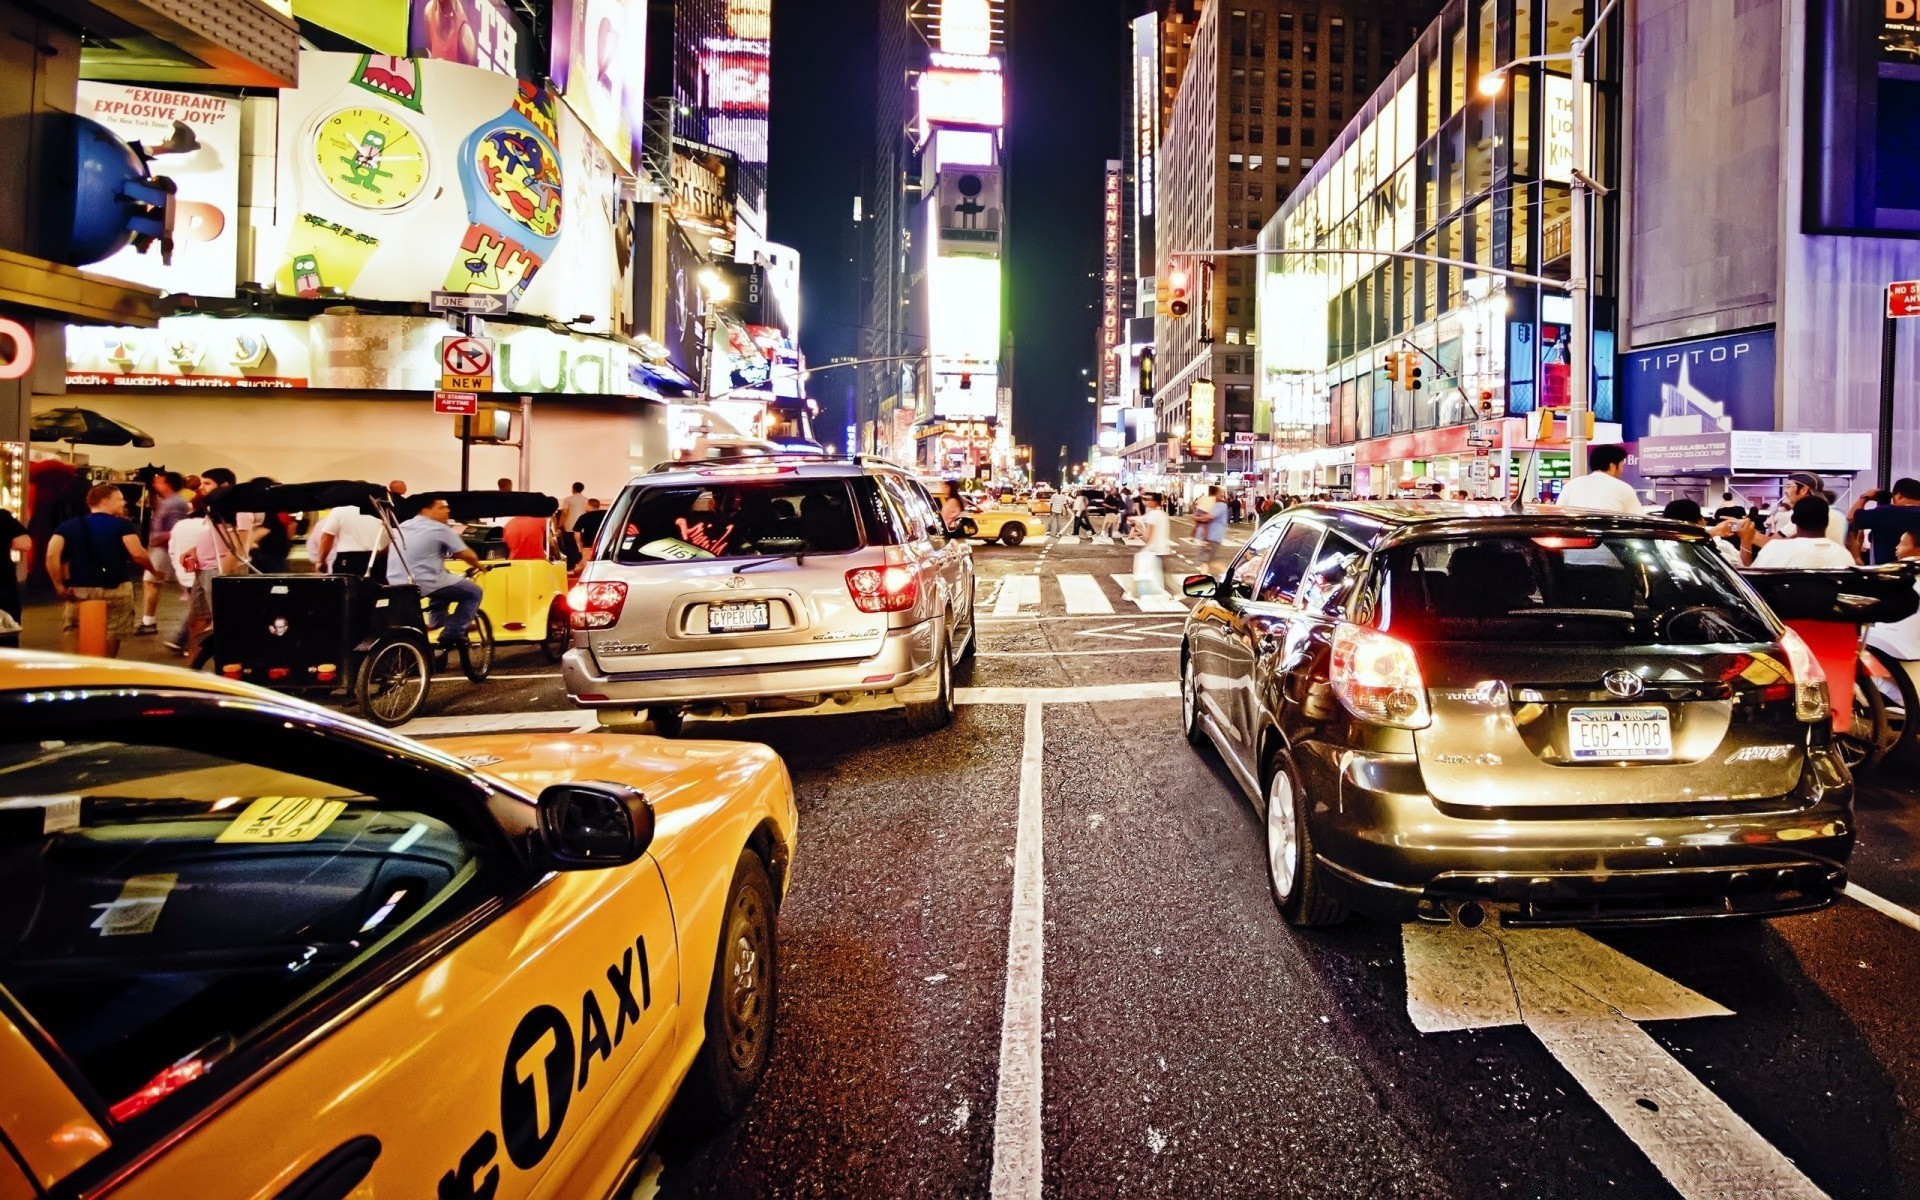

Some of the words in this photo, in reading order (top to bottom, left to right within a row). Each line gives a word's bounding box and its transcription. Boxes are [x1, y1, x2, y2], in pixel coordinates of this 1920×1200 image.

[125, 89, 226, 111] "EXUBERANT!
[1556, 97, 1574, 112] TH
[94, 99, 176, 120] EXPLOSIVE
[181, 110, 226, 125] JOY!"
[107, 115, 117, 123] The
[135, 119, 149, 127] York
[151, 121, 169, 129] Times
[378, 114, 390, 126] 12
[1551, 115, 1574, 138] LIO
[1550, 142, 1573, 166] KIN
[1353, 149, 1375, 193] THE
[1106, 176, 1118, 254] ERNST
[750, 265, 759, 303] 1500
[1894, 286, 1907, 295] NO
[442, 297, 463, 307] ONE
[474, 299, 496, 308] WAY
[1104, 298, 1117, 378] YOUNG
[1639, 353, 1679, 372] TIP
[1691, 343, 1750, 365] TOP
[113, 376, 162, 386] swatch
[452, 377, 482, 389] NEW
[1668, 442, 1726, 451] AVAILABILITIES
[1580, 723, 1610, 747] EGD
[1622, 722, 1661, 747] 1008
[501, 935, 651, 1170] TAXI
